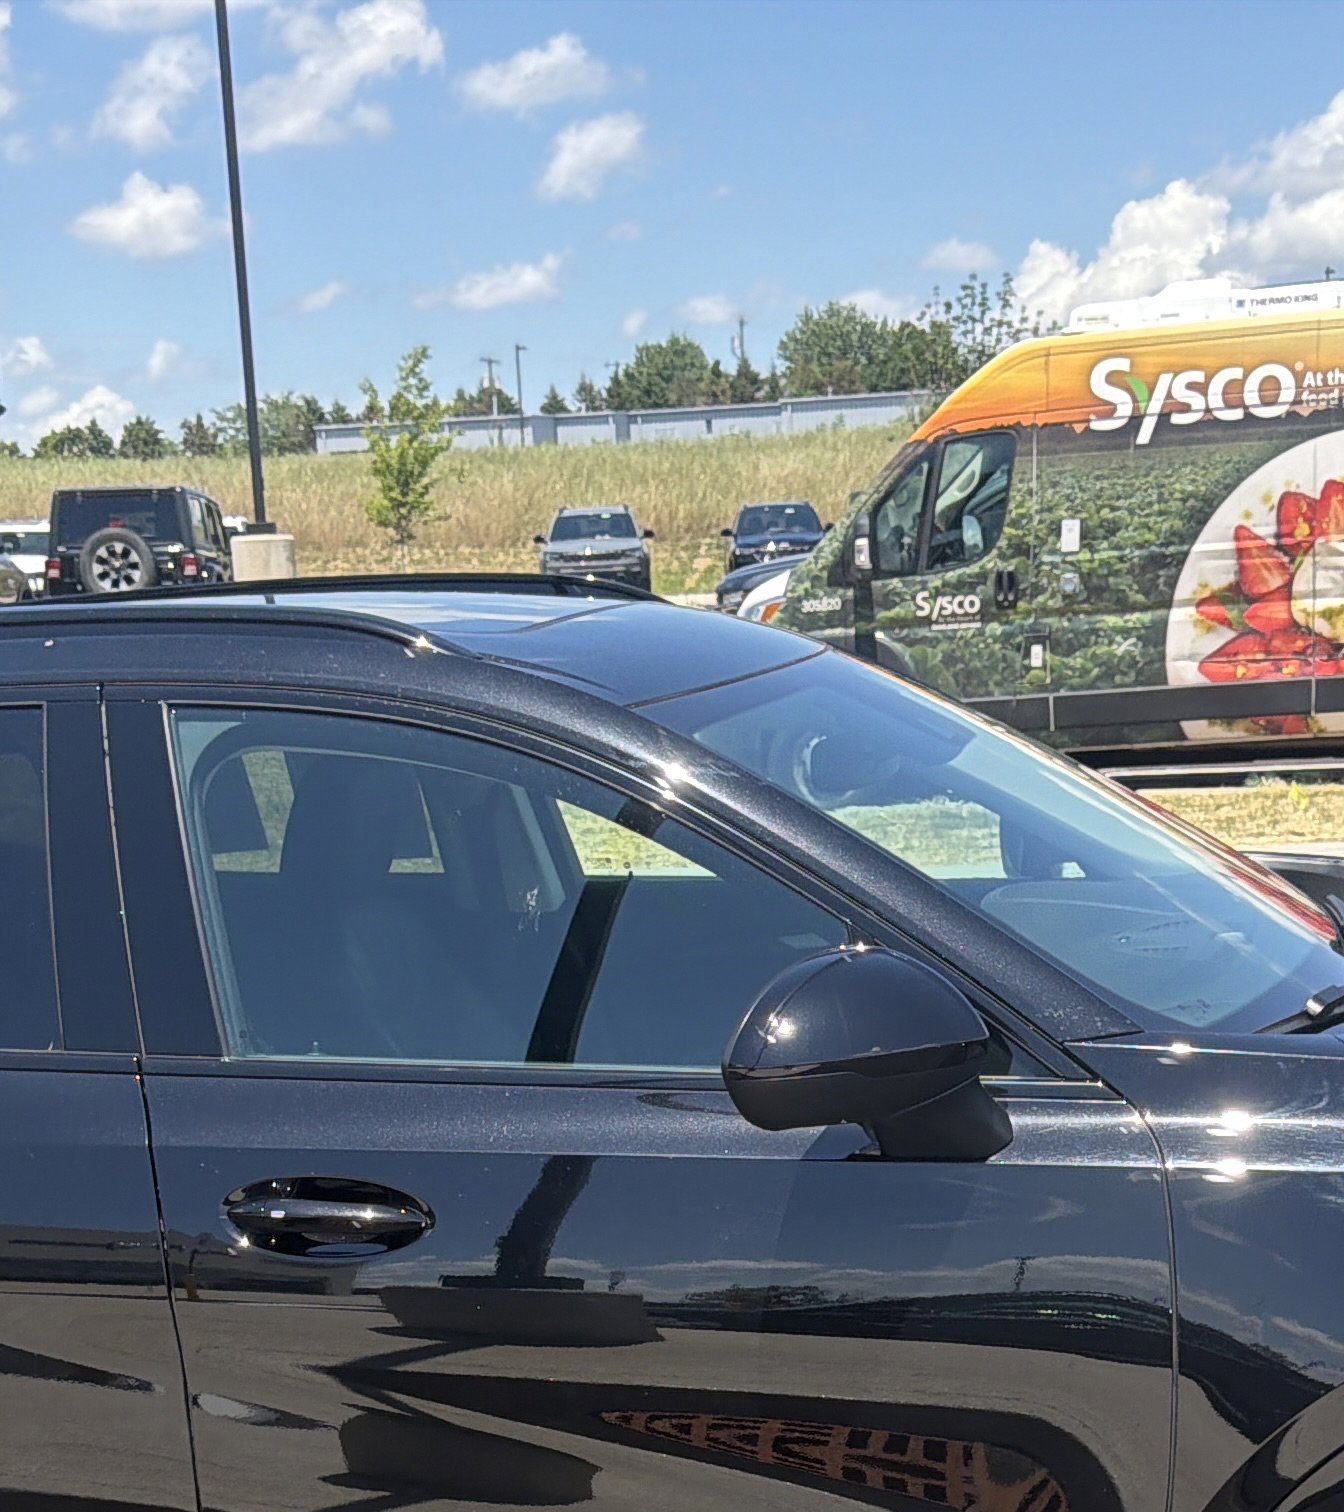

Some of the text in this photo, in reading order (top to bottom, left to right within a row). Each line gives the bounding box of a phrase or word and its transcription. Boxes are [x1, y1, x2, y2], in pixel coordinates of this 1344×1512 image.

[1249, 295, 1292, 307] THERMO
[1302, 370, 1323, 388] At
[1300, 387, 1339, 407] food
